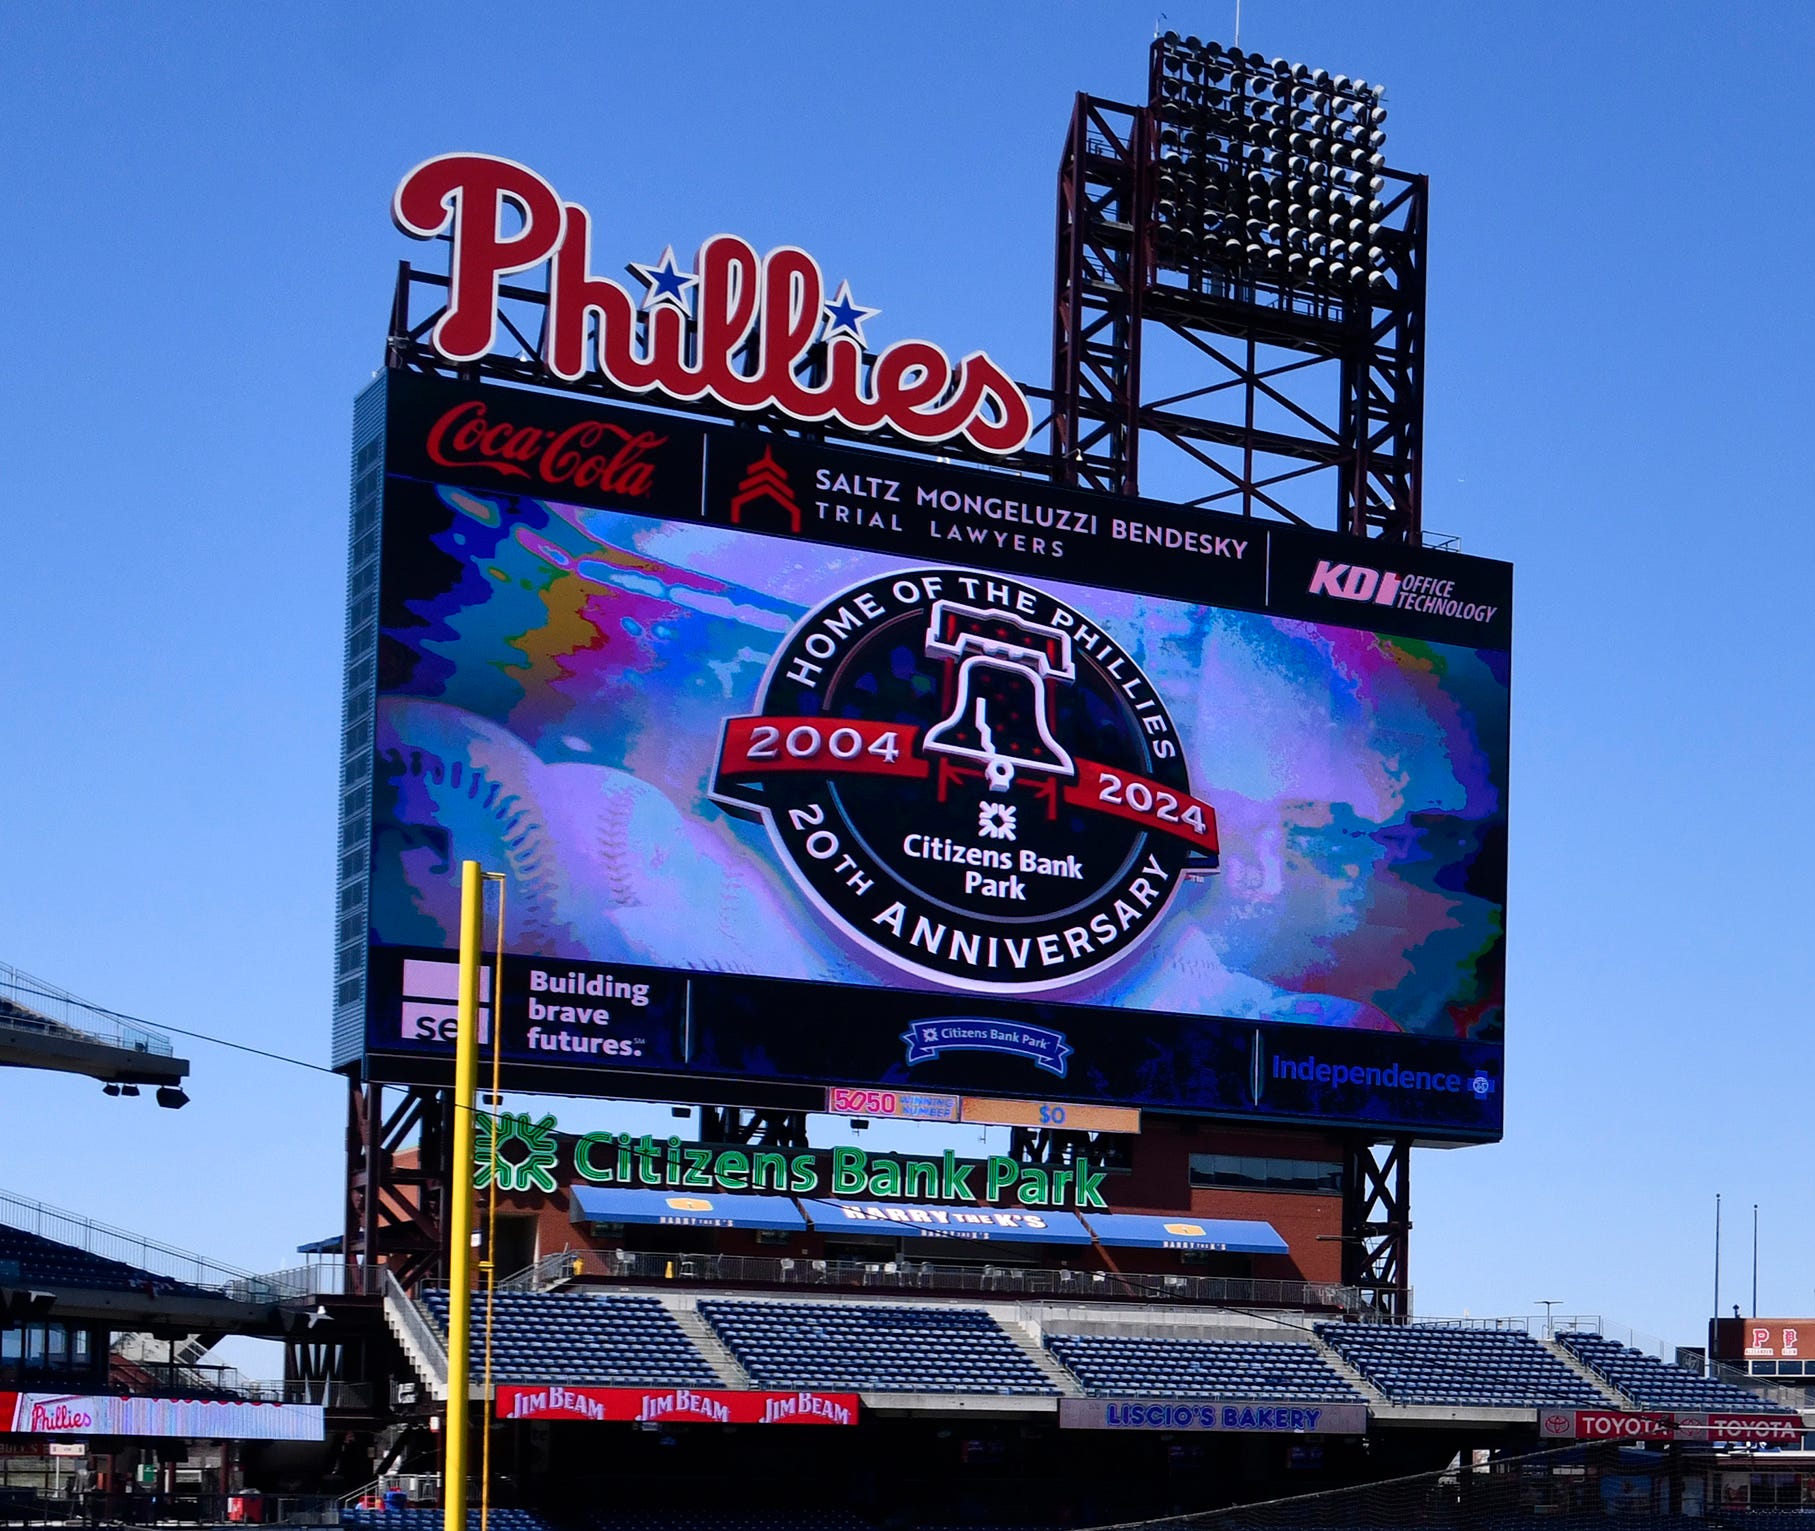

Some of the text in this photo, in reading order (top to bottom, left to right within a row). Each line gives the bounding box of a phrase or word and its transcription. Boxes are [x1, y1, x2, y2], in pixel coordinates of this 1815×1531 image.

[392, 152, 1033, 455] Phillies
[816, 467, 1249, 560] SALTZ MONGELUZZI BENDESKY
[816, 501, 1065, 558] TRIAL LAWYERS
[1307, 559, 1402, 606] KDI
[1401, 573, 1456, 598] OFFICE
[1398, 588, 1498, 624] TECHNOLOGY
[785, 575, 1177, 761] HOME OF THE PHILLIES
[746, 724, 900, 765] 2004
[1098, 772, 1208, 835] 2024
[903, 832, 1083, 880] Citizens Bank
[788, 802, 1172, 969] 20TH ANNIVERSARY
[964, 869, 1026, 901] Park
[529, 970, 650, 1006] Building
[528, 998, 609, 1025] brave
[527, 1027, 643, 1057] futures.
[940, 1027, 1020, 1044] Citizens Bank
[1272, 1055, 1461, 1094] Independence
[902, 1107, 952, 1118] NUMBER
[1039, 1105, 1066, 1124] $0
[573, 1130, 1108, 1208] Citizens Bank Park
[842, 1203, 1048, 1229] HARRY THE K'S
[635, 1390, 731, 1423] JIM BEAM
[759, 1392, 851, 1425] JIM BEAM
[1108, 1404, 1321, 1430] LISCIO'S BAKERY
[1583, 1416, 1669, 1435] TOYOTA
